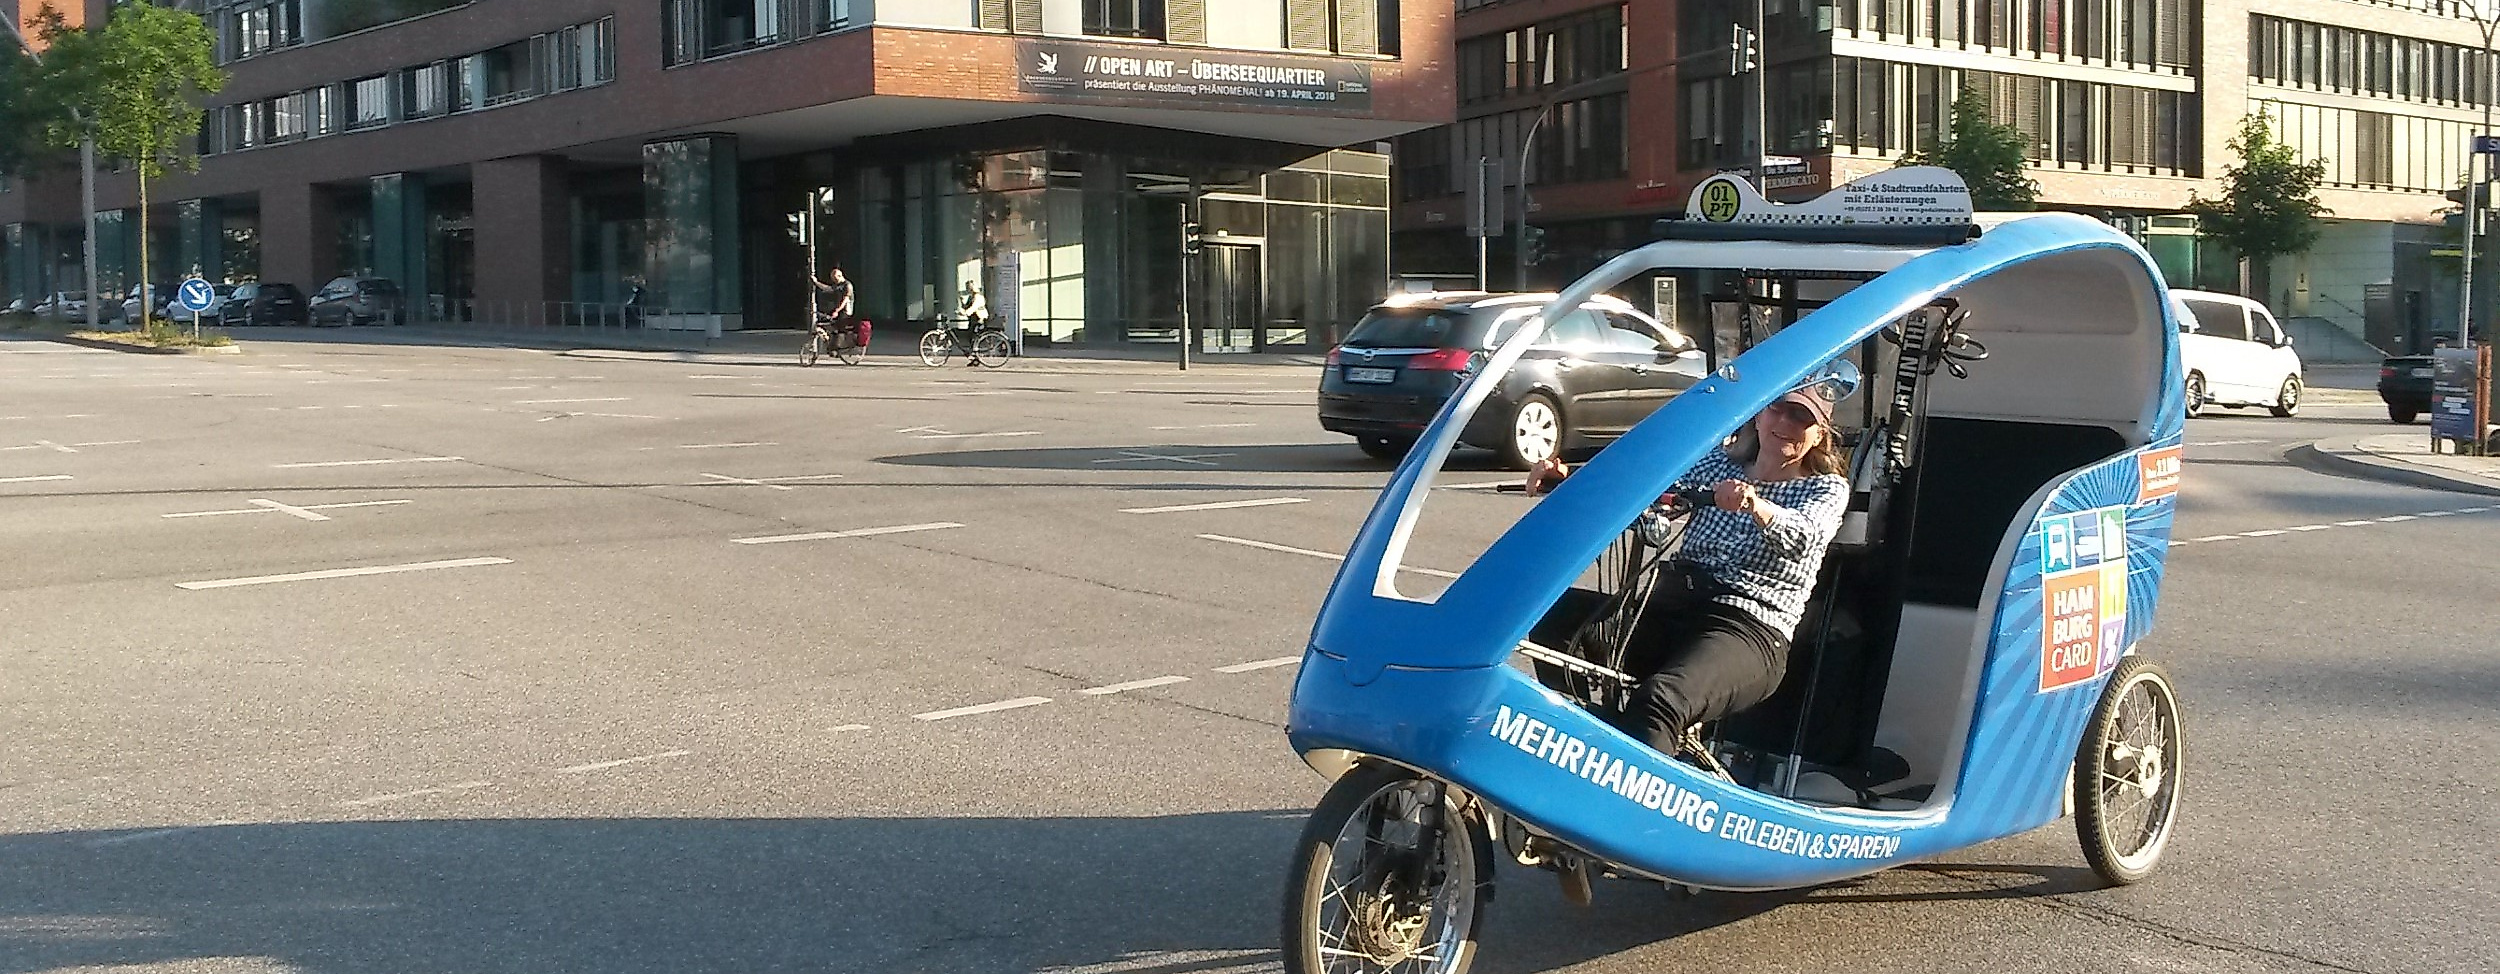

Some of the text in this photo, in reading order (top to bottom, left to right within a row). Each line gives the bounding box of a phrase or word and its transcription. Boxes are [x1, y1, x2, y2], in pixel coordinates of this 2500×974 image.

[1100, 56, 1141, 76] OPEN
[1144, 59, 1175, 77] ART
[1191, 58, 1326, 86] ÜBERSEEQUARTIER
[1084, 79, 1131, 90] präsentiert
[1132, 80, 1146, 91] die
[1147, 81, 1197, 95] Ausstellung
[1264, 88, 1275, 98] ab
[1277, 89, 1289, 99] 19.
[1291, 90, 1313, 100] APRIL
[1315, 91, 1335, 101] 2018
[1711, 185, 1729, 201] 01
[1844, 195, 1862, 203] mit
[1870, 183, 1880, 193] &
[1881, 183, 1966, 193] Stadtrundfahrten
[1709, 202, 1734, 217] PT
[2053, 585, 2094, 616] HAM
[2053, 613, 2093, 645] BURG
[2051, 641, 2092, 672] CARD
[1490, 704, 1586, 774] MEHR
[1580, 747, 1719, 833] HAMBURG
[1720, 811, 1811, 858] ERLEBEN
[1824, 834, 1900, 859] SPAREN!
